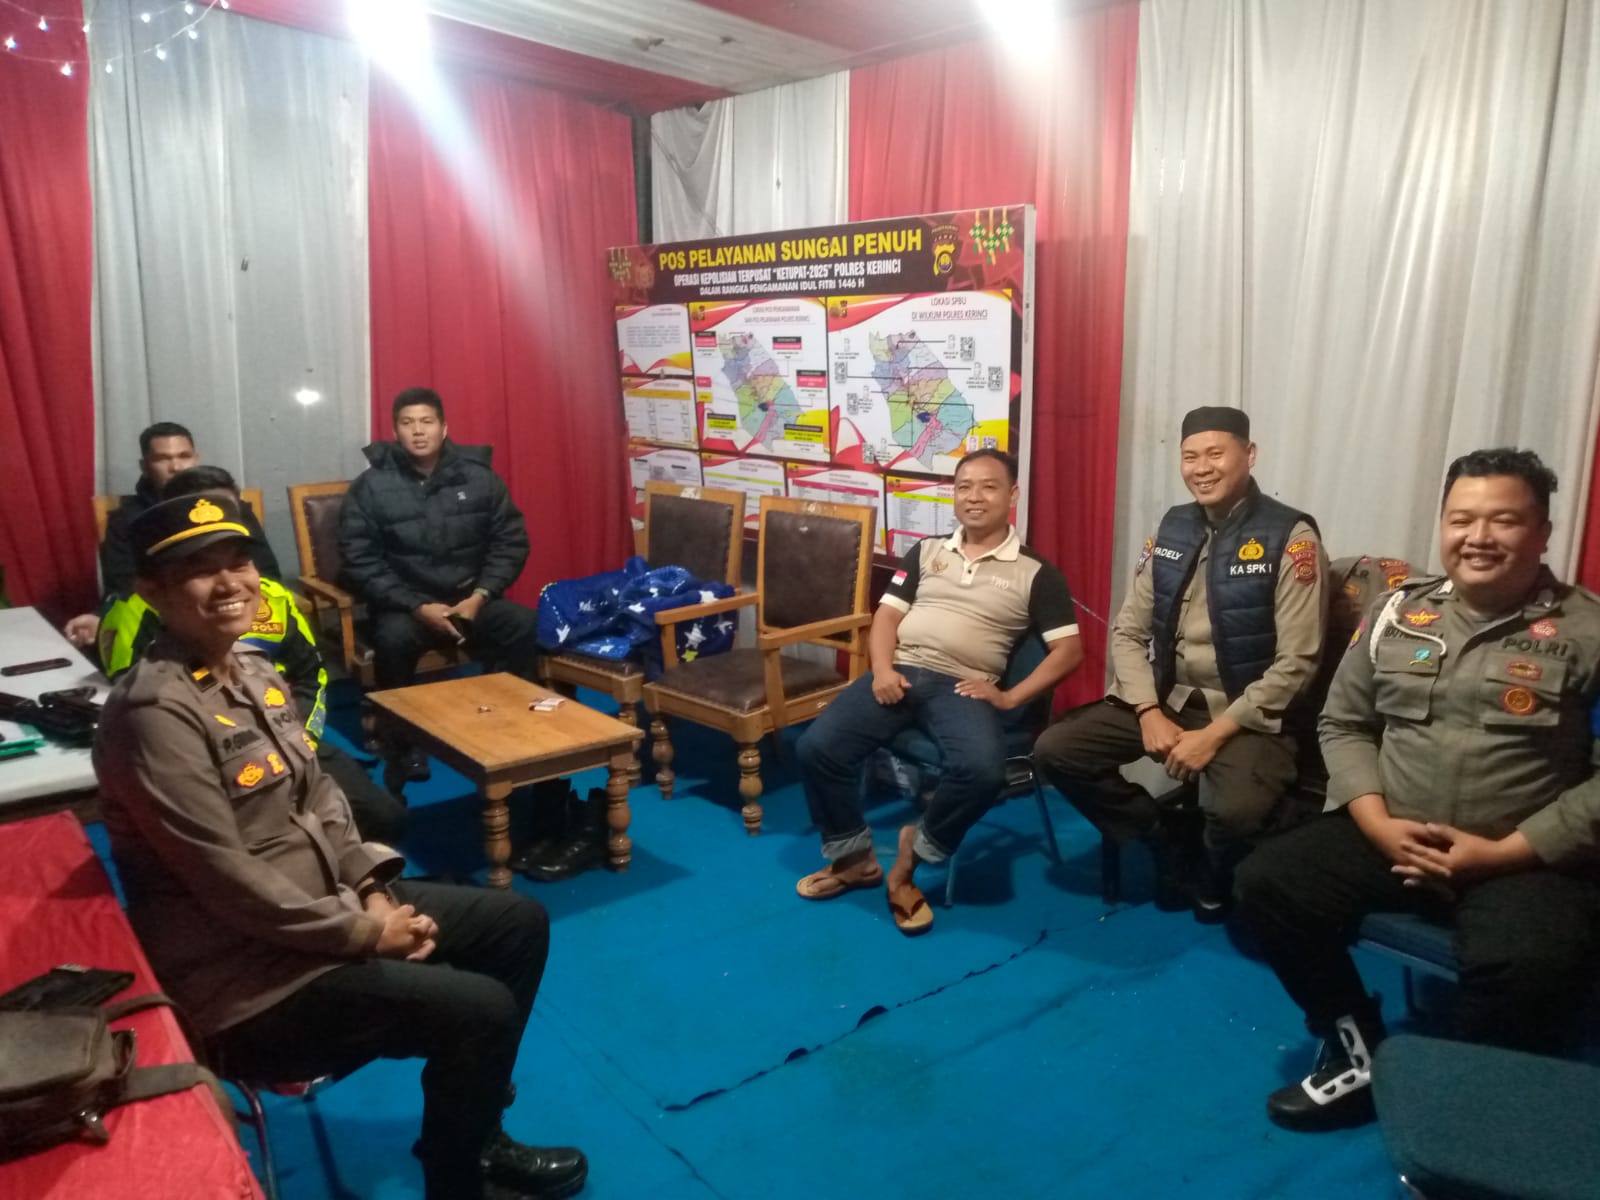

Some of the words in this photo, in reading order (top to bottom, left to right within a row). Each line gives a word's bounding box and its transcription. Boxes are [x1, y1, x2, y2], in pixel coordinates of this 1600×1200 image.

[659, 252, 686, 271] POS
[689, 242, 776, 268] PELAYANAN
[781, 235, 848, 261] SUNGAI
[853, 228, 922, 256] PENUH
[674, 274, 699, 286] OPERASI
[700, 271, 737, 285] KEPOLISIAN
[738, 267, 771, 283] TERPUSAT
[834, 261, 865, 277] POLRES
[866, 258, 901, 275] KERINCI
[700, 285, 721, 295] DALAM
[749, 281, 799, 293] PENGAMANAN
[800, 280, 817, 290] IDUL
[818, 279, 836, 290] FITRI
[838, 278, 857, 289] 1446
[858, 278, 865, 288] H
[1230, 565, 1244, 575] KA
[1246, 564, 1267, 575] SPK
[1502, 637, 1569, 657] POLRI
